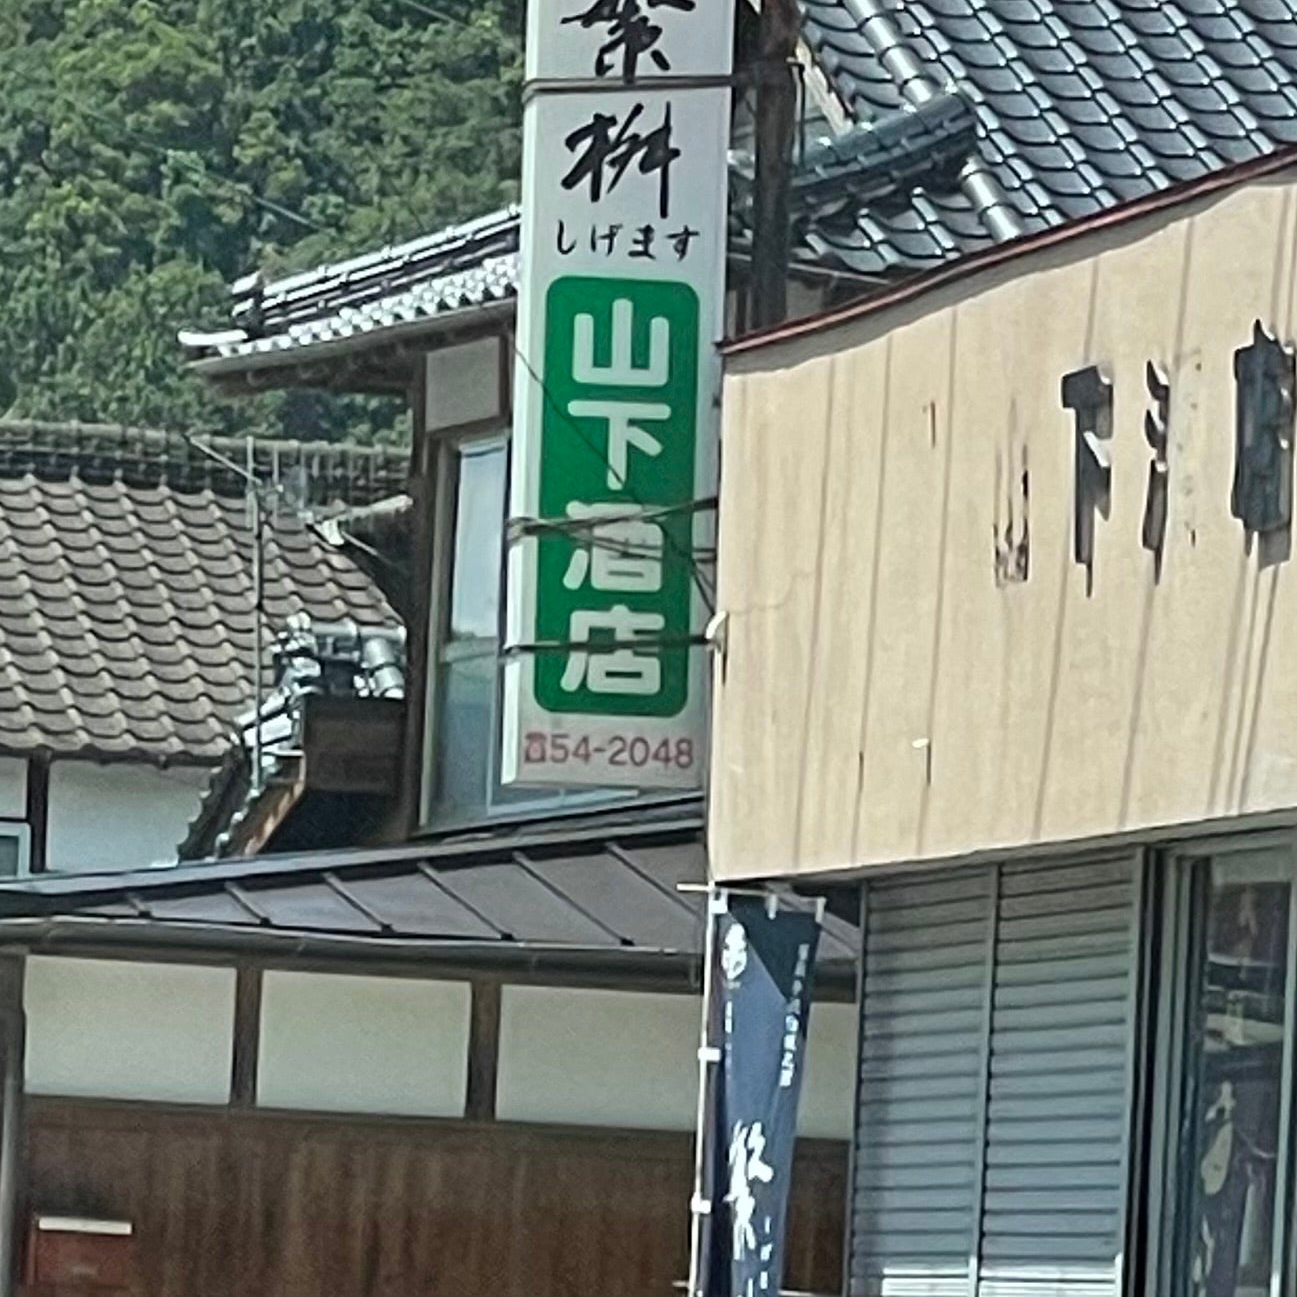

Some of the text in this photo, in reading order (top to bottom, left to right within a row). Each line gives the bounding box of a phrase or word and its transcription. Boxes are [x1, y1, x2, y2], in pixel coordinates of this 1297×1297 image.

[555, 219, 701, 262] しげます
[560, 297, 672, 696] 山下酒店
[549, 733, 695, 770] 54-2048
